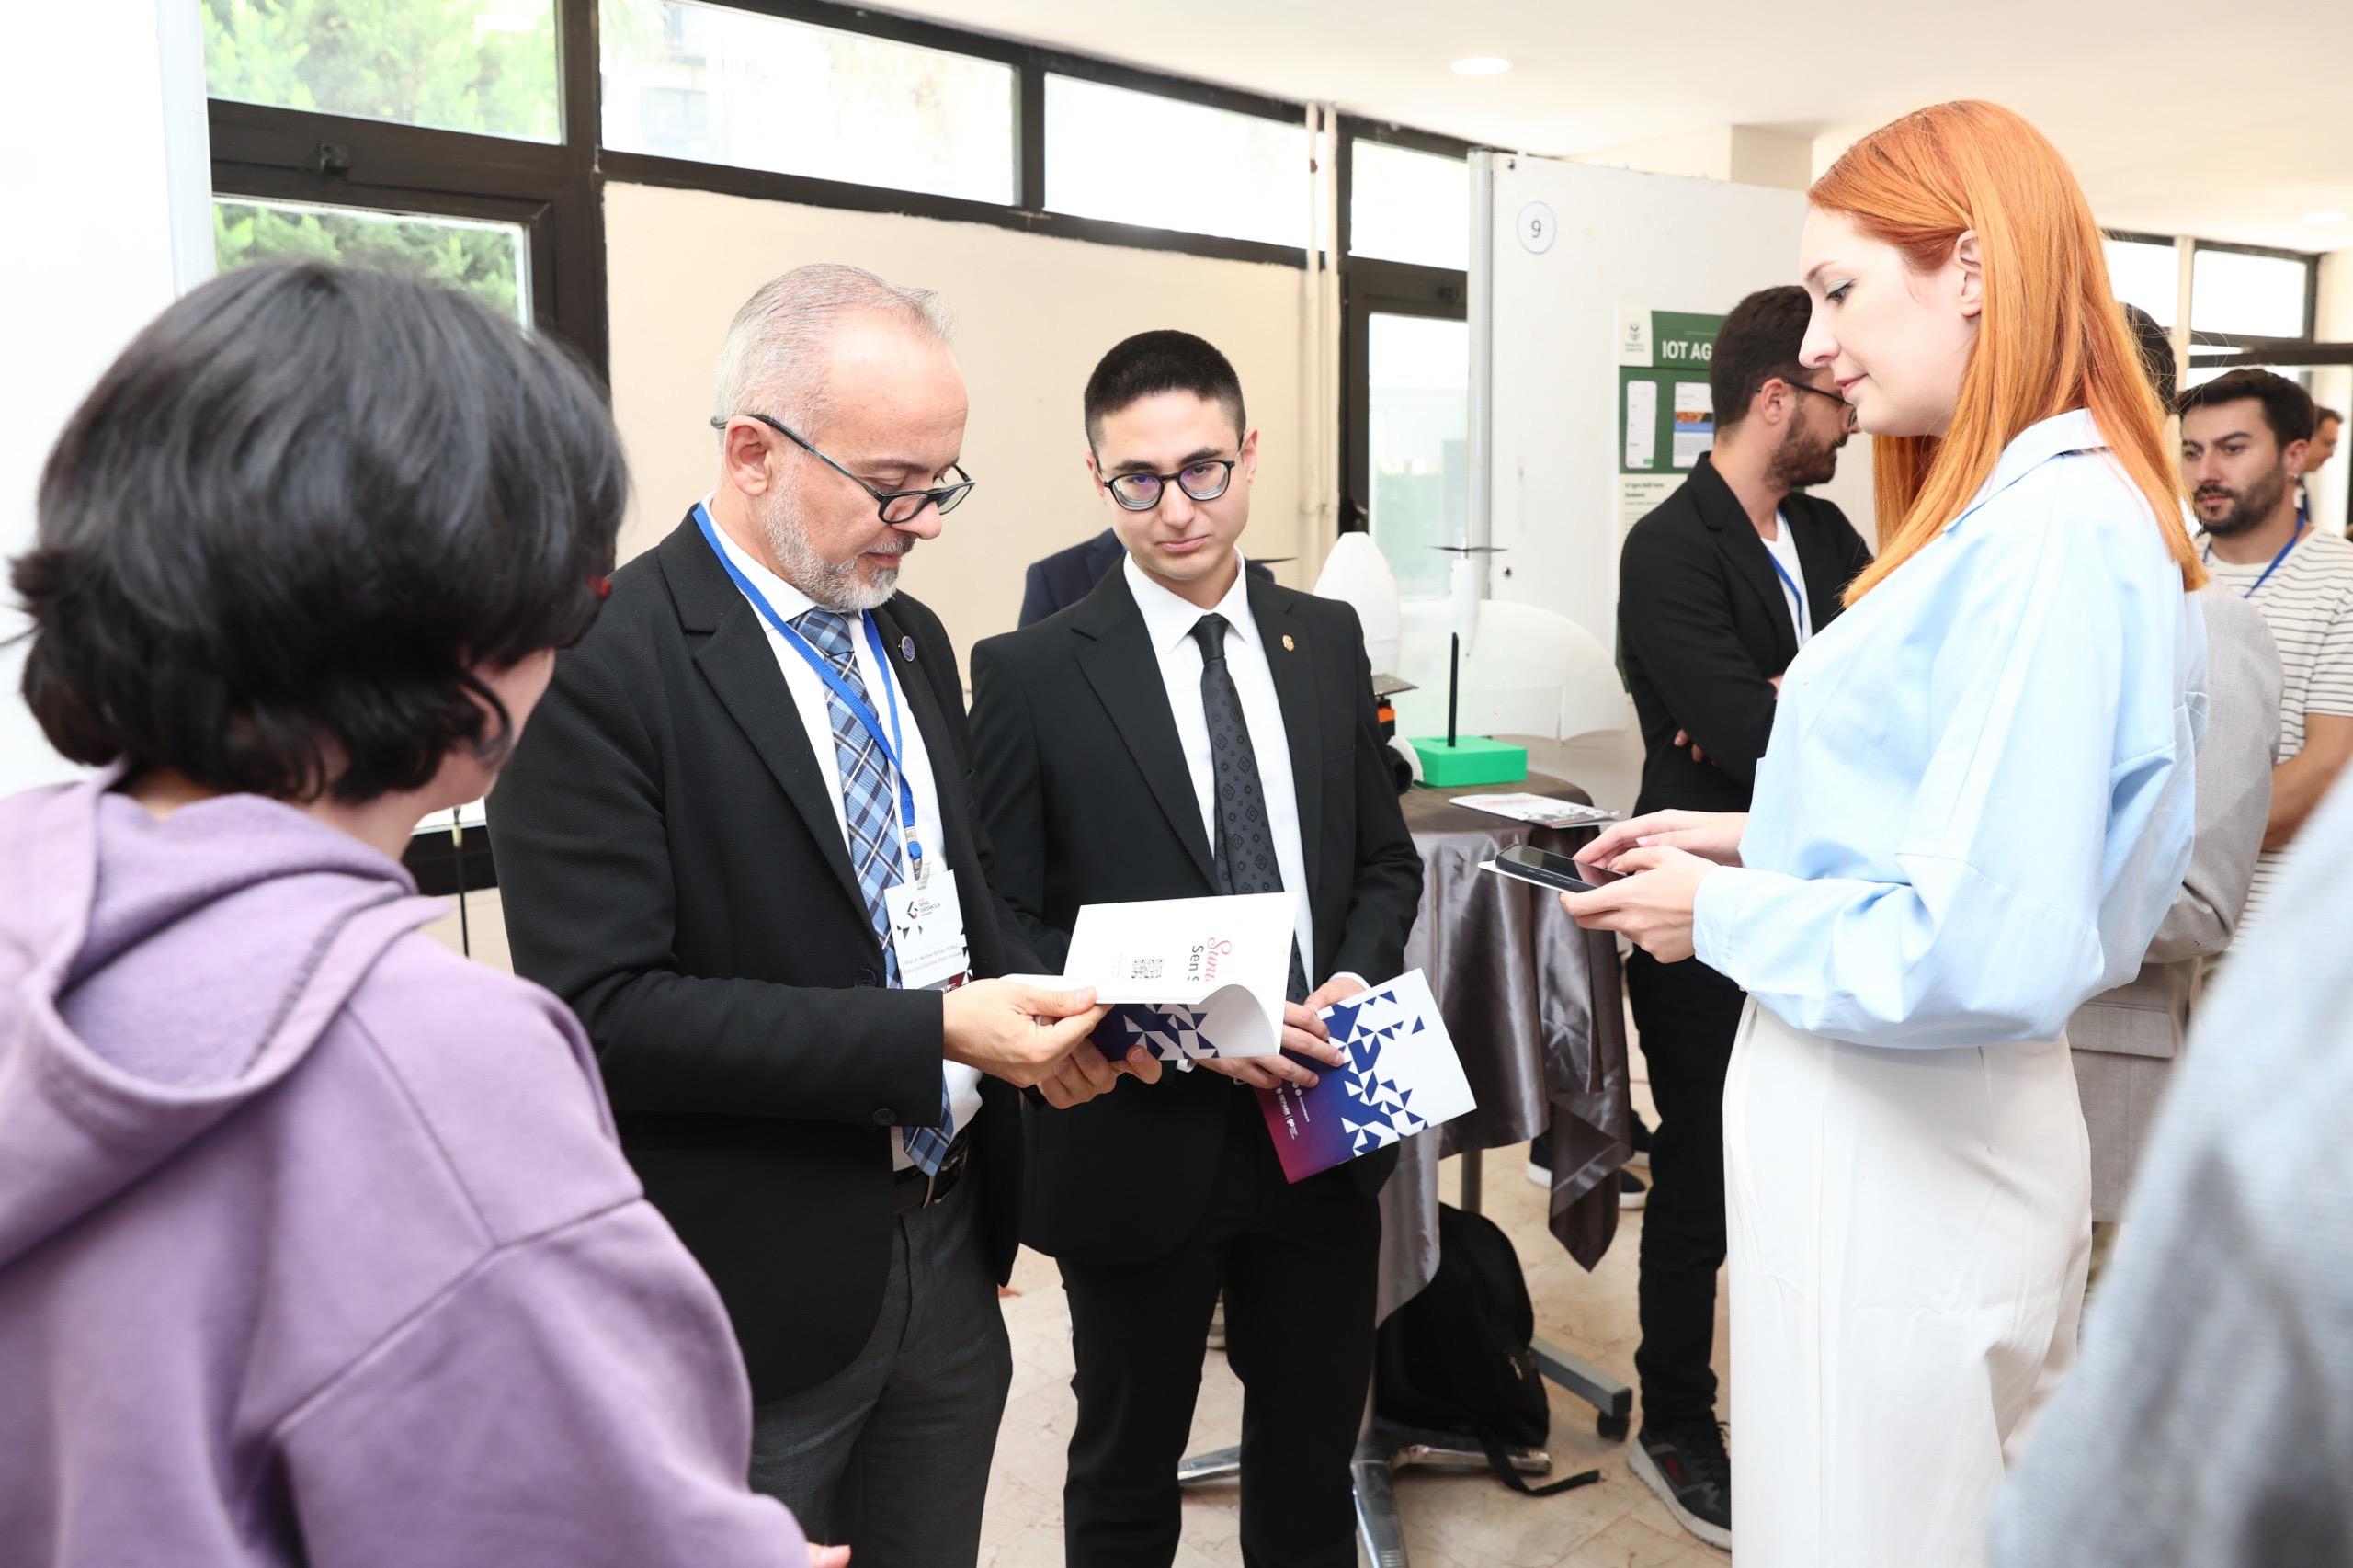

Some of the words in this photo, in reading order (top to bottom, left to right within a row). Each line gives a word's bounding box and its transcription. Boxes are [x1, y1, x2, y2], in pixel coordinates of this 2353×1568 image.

[1531, 219, 1541, 238] 9
[1662, 340, 1688, 359] IOT
[1188, 945, 1204, 971] Sen
